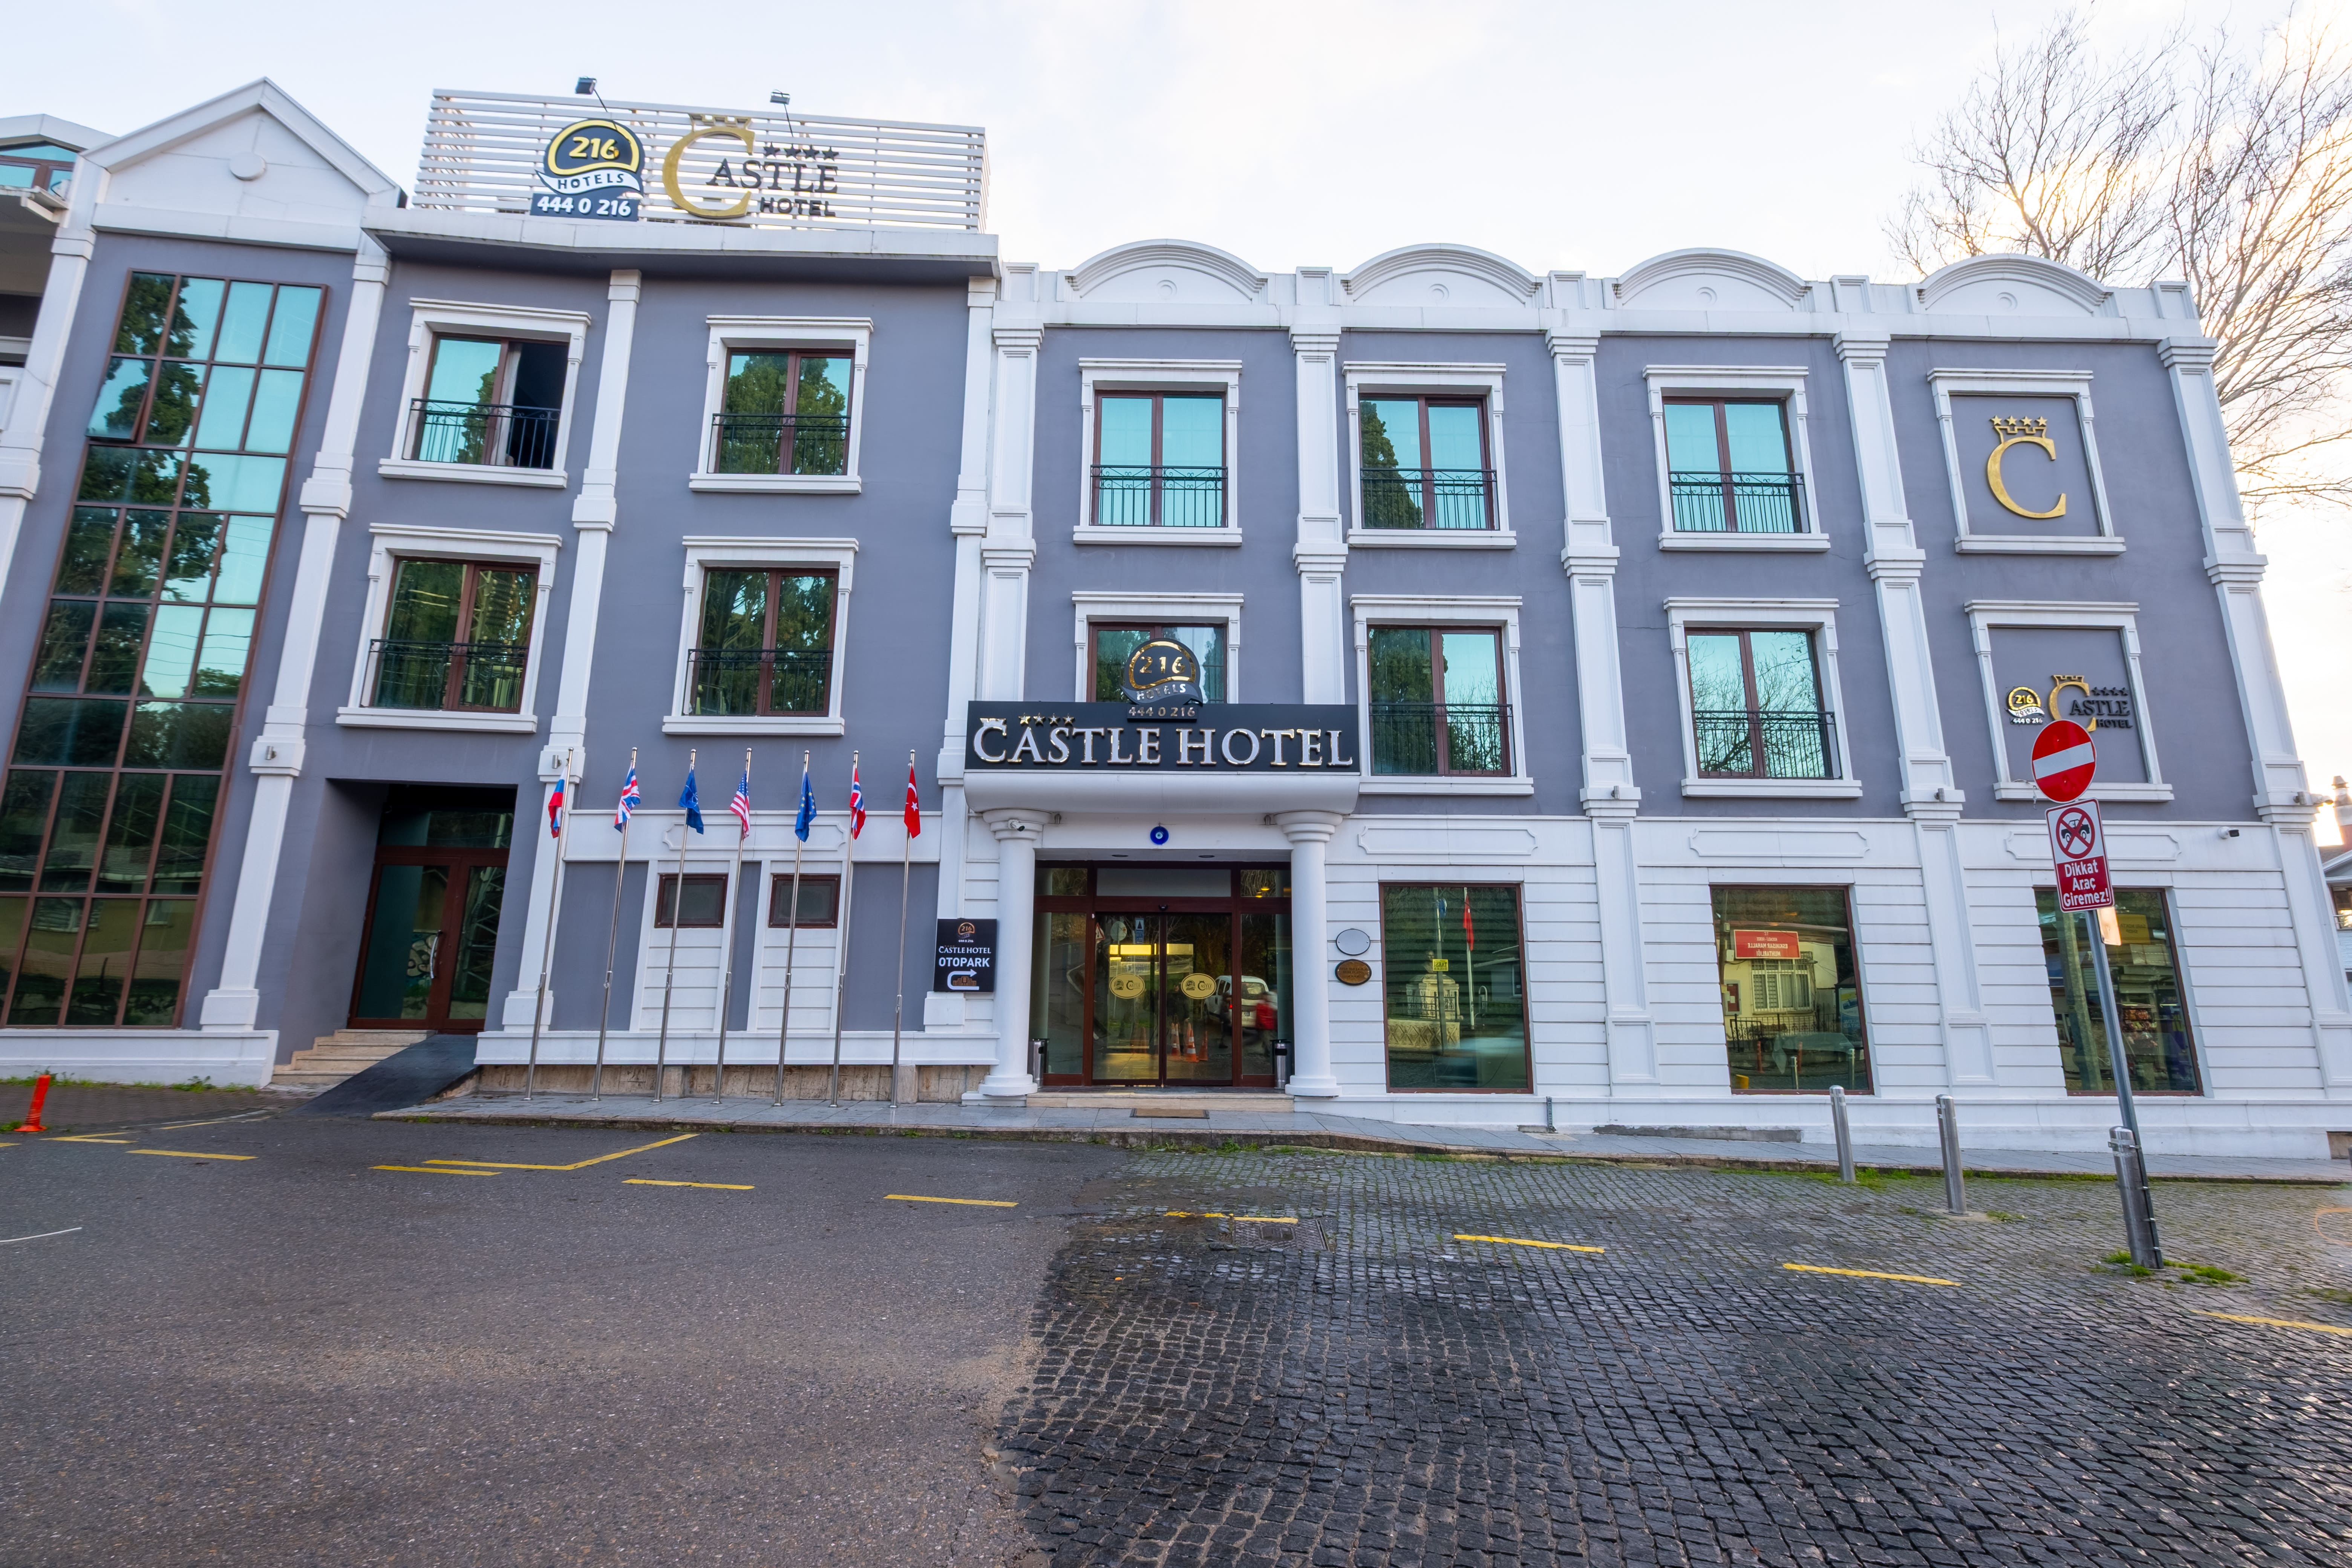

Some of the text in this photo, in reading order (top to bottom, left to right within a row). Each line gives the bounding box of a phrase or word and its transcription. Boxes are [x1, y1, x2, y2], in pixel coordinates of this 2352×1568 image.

[569, 136, 619, 159] 216
[558, 173, 624, 189] HOTELS
[537, 196, 631, 217] 444 0 216
[760, 196, 836, 217] HOTEL
[1987, 436, 2066, 519] C
[1139, 657, 1185, 674] 216
[1136, 683, 1186, 700] HOTELS
[2014, 695, 2034, 704] 216
[1129, 707, 1196, 717] 444 0 216
[2096, 719, 2133, 728] HOTEL
[973, 724, 1353, 767] CASTLE HOTEL
[2064, 859, 2099, 877] Dikkat
[2072, 877, 2096, 891] Araç
[2063, 888, 2110, 906] Giremez!
[939, 957, 990, 967] OTOPARK
